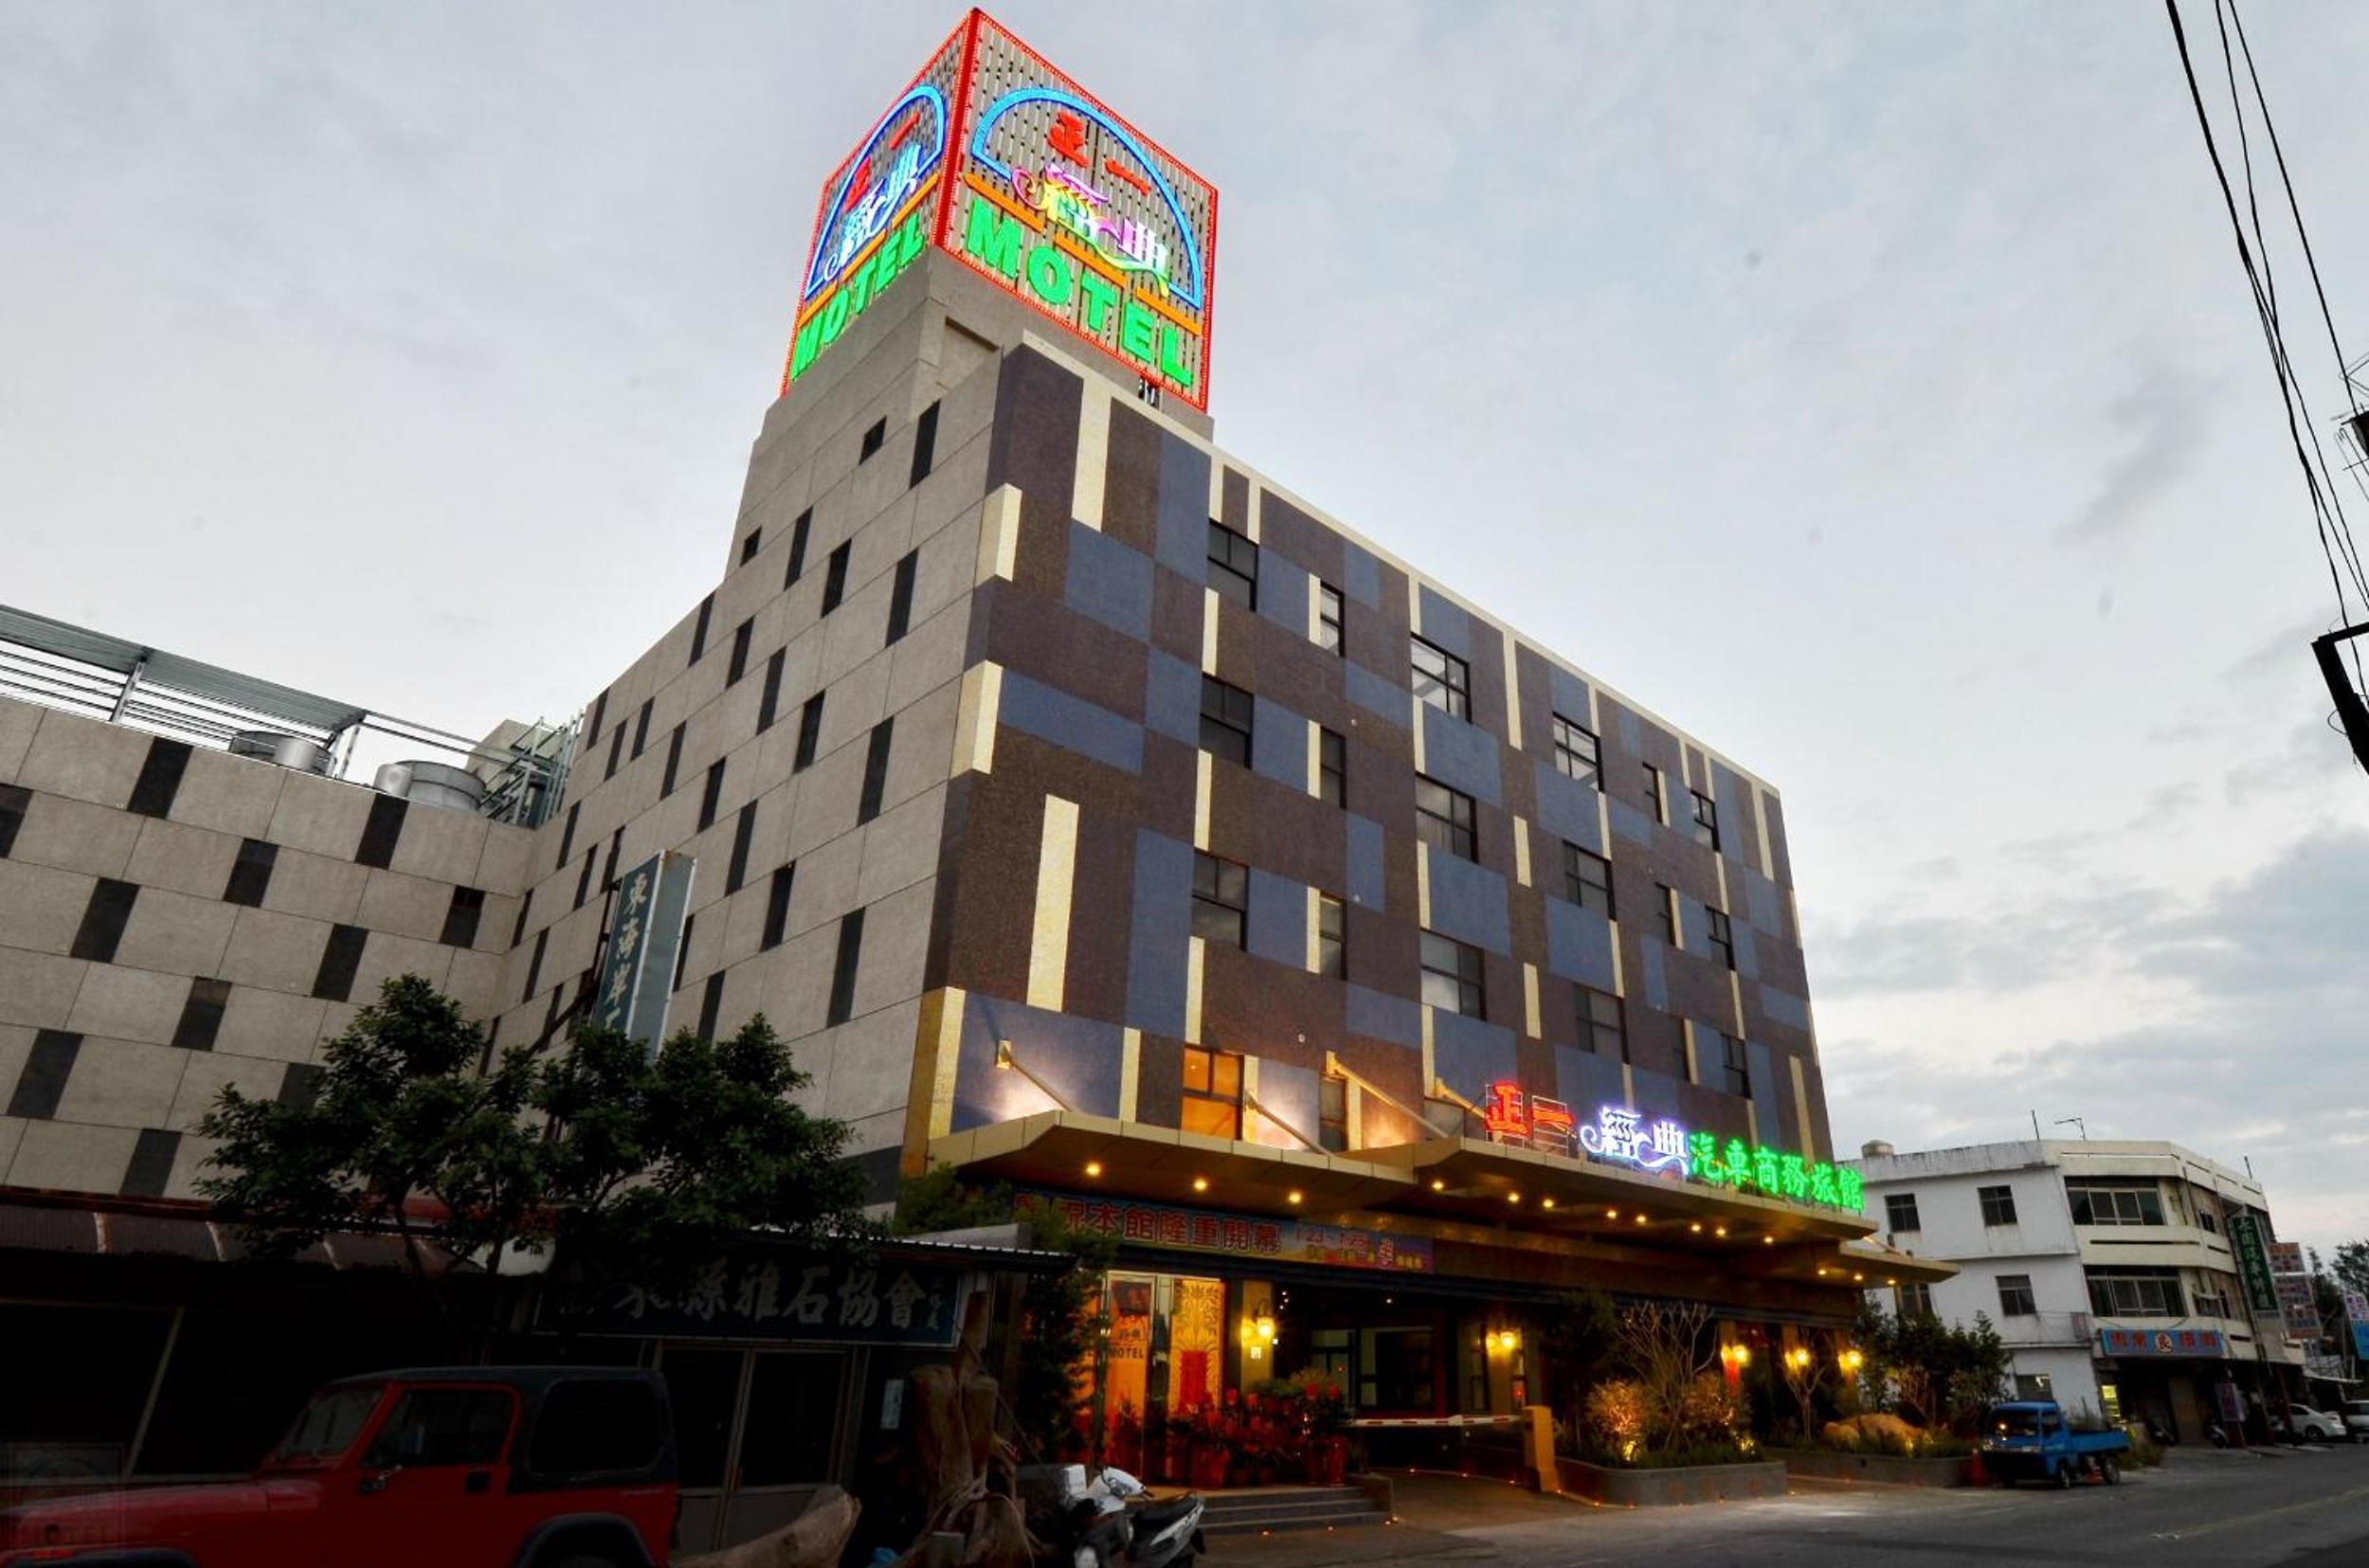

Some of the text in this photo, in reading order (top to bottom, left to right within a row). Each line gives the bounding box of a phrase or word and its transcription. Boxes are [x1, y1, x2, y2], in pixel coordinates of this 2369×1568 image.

[792, 213, 926, 381] MOTEL
[965, 197, 1193, 387] MOTEL
[1689, 1133, 1864, 1212] 汽車商務旅館
[1110, 1346, 1144, 1359] MOTEL
